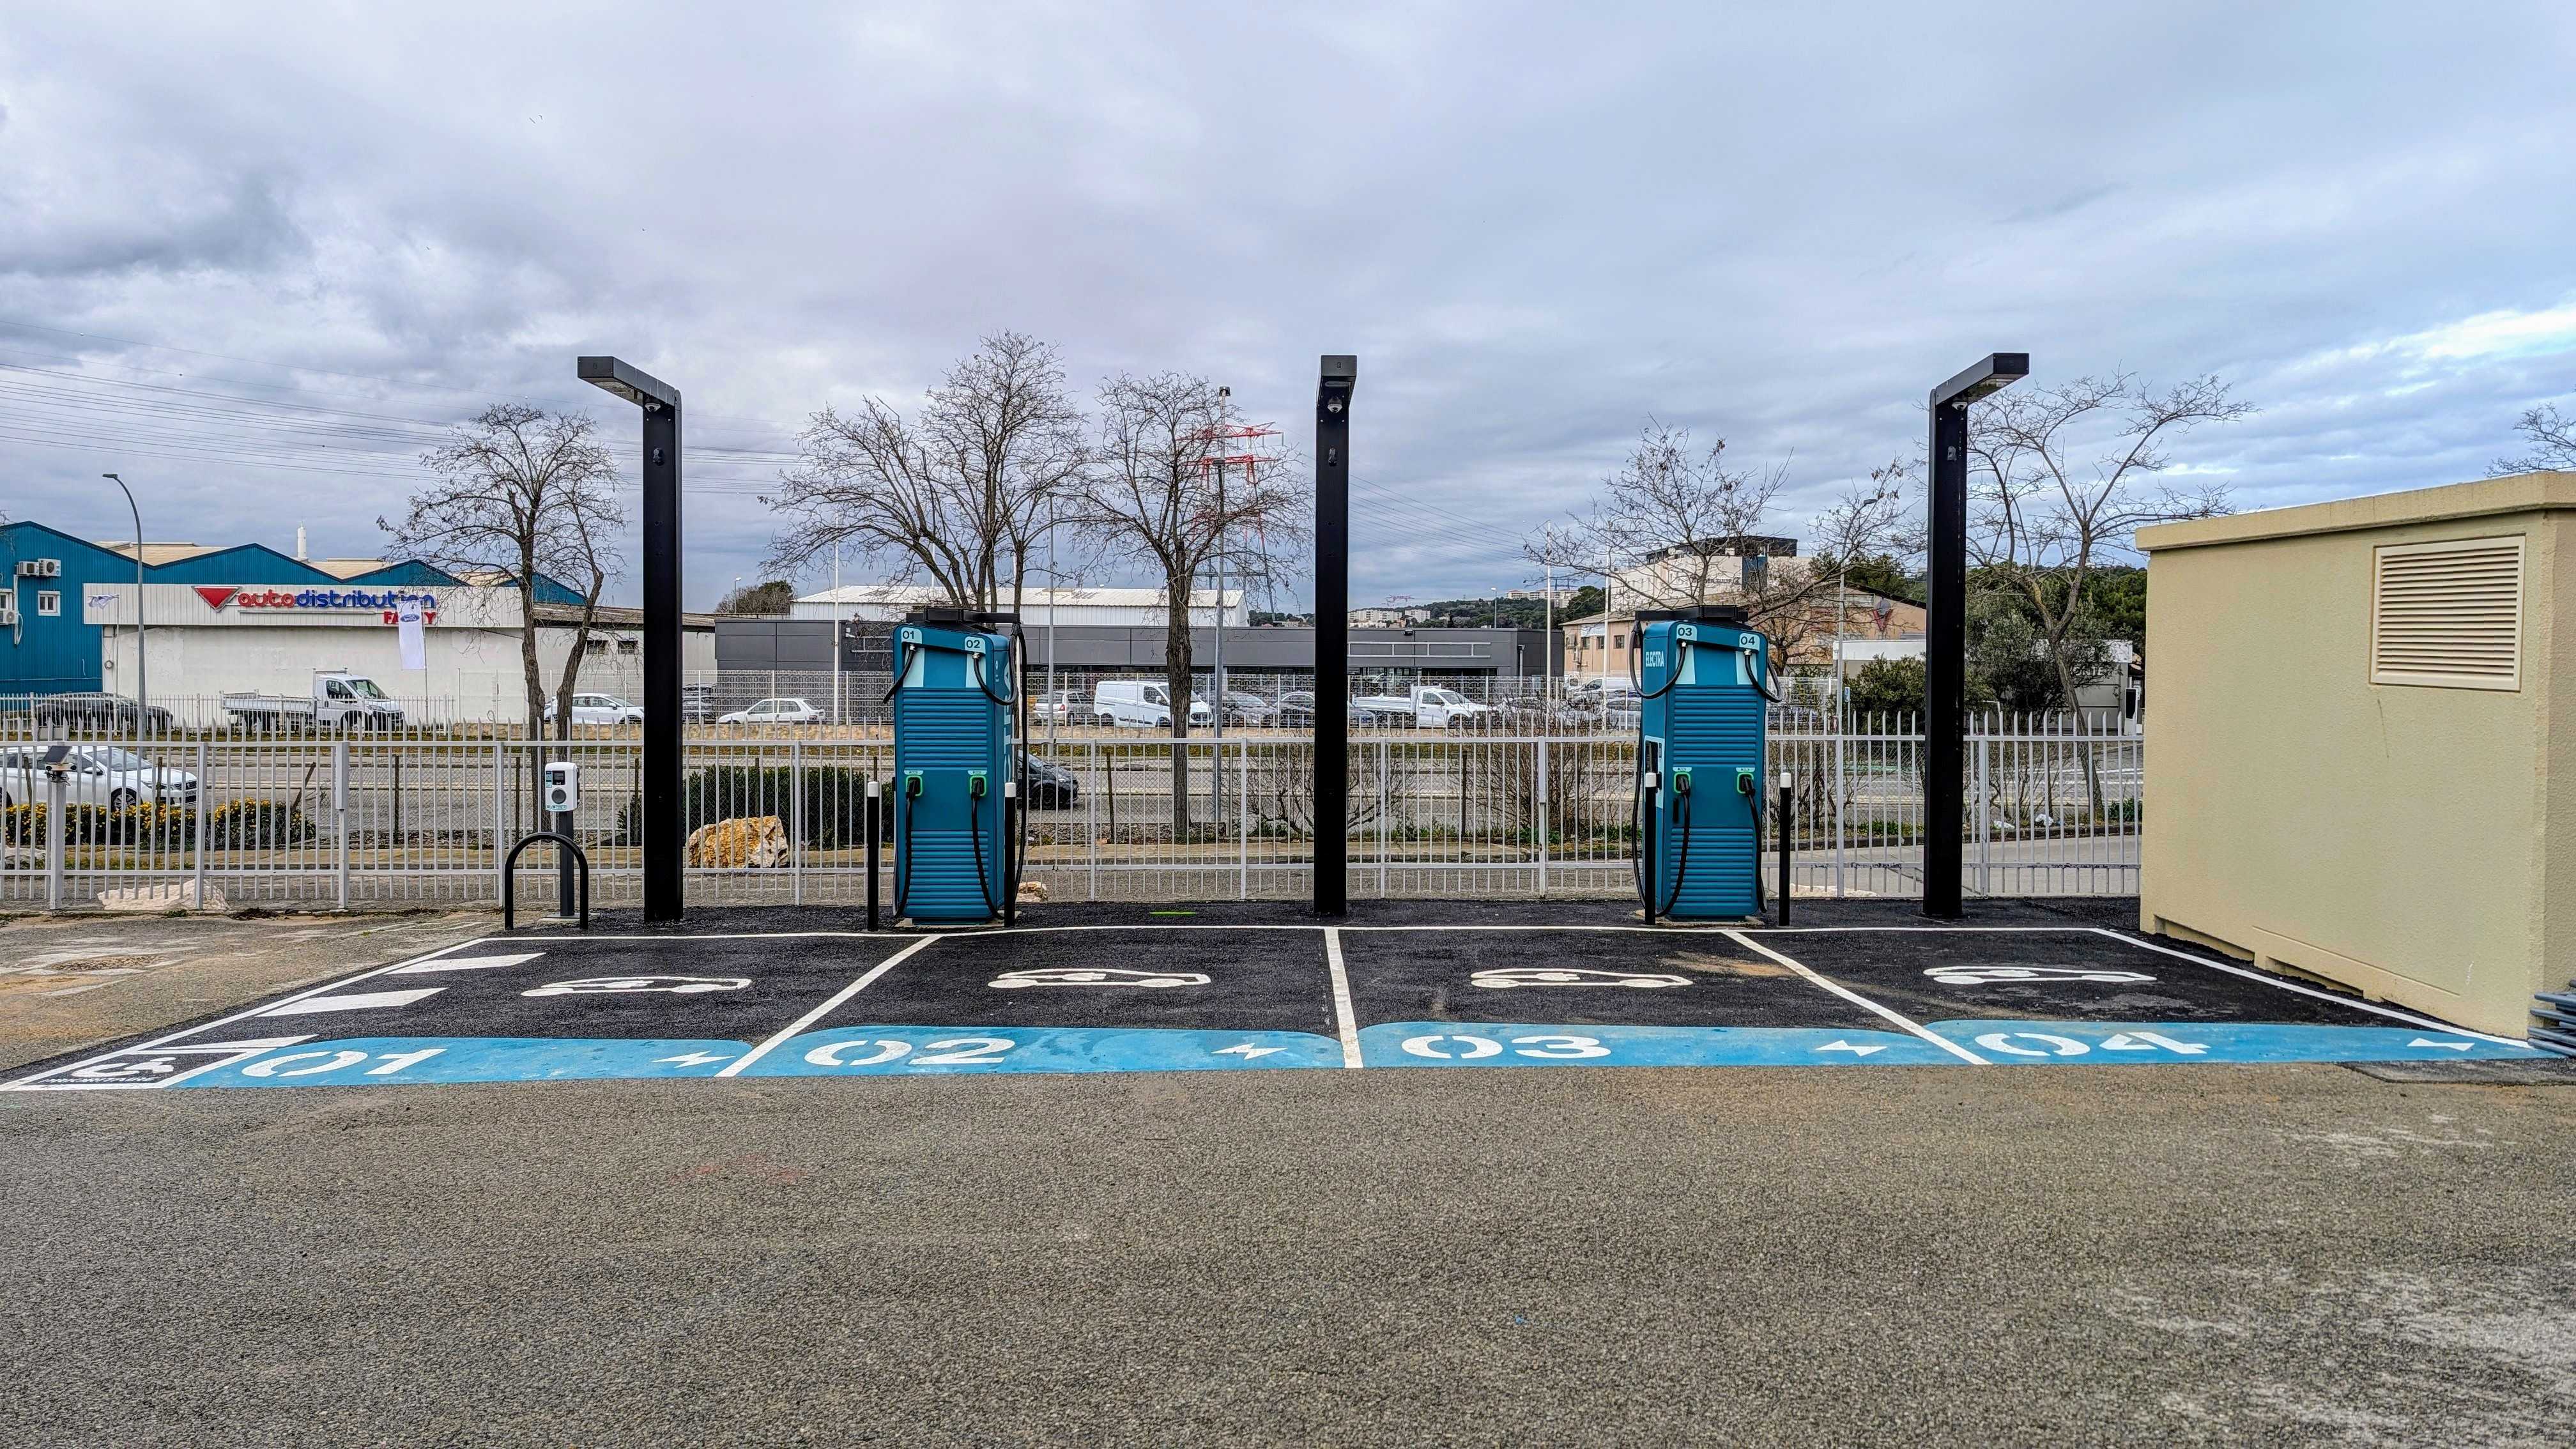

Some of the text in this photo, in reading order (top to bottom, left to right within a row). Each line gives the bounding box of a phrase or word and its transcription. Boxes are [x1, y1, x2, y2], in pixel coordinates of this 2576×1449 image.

[902, 630, 915, 640] 01
[1678, 627, 1692, 636] 03
[966, 640, 981, 648] 02
[1740, 636, 1756, 645] 04
[1645, 651, 1664, 668] ELECTRA
[804, 1038, 1015, 1066] 02
[1401, 1035, 1611, 1059] 03
[1975, 1032, 2211, 1055] 04
[241, 1048, 447, 1077] 01
